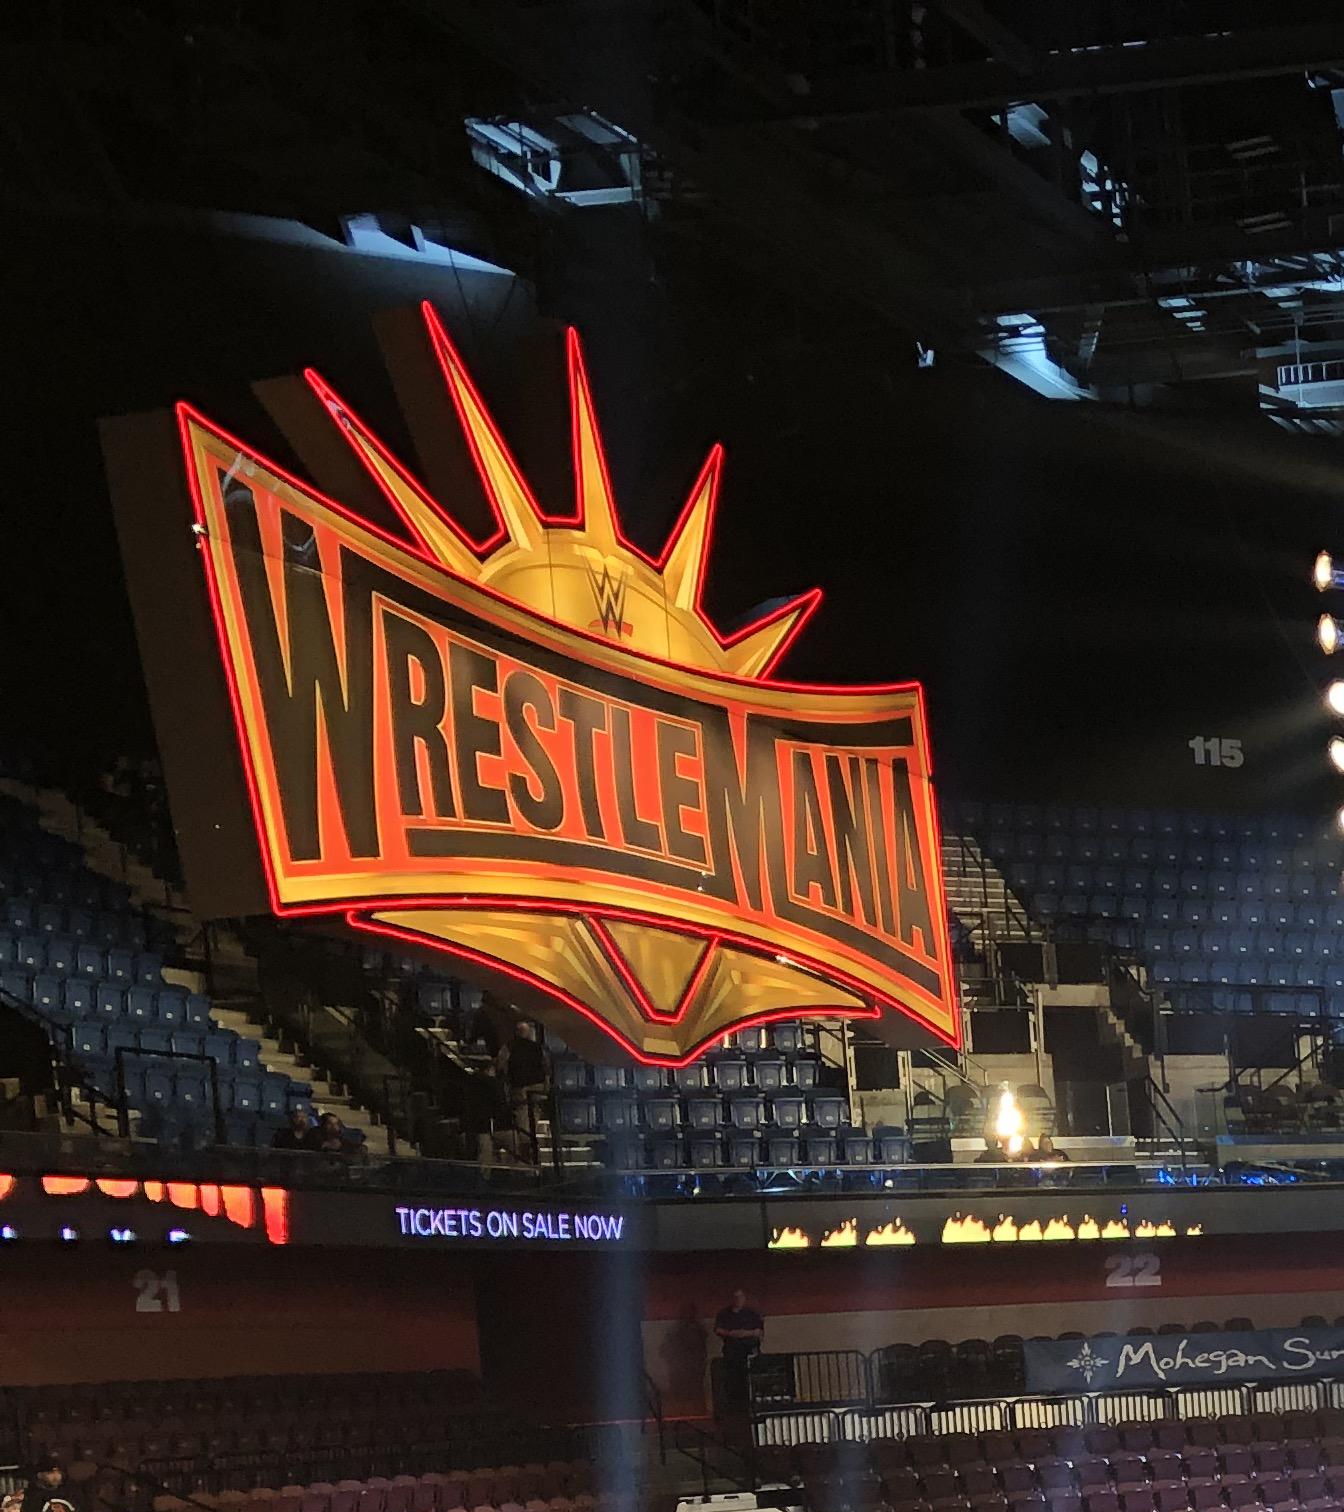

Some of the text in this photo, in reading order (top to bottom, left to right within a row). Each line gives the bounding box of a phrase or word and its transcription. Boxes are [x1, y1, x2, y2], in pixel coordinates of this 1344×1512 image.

[212, 466, 943, 999] WRESTLEMANIA
[1187, 735, 1244, 768] 115
[395, 1207, 624, 1241] TICKETS ON SALE NOW
[1104, 1253, 1162, 1288] 22
[132, 1269, 181, 1313] 21
[1115, 1338, 1277, 1381] Mohegan
